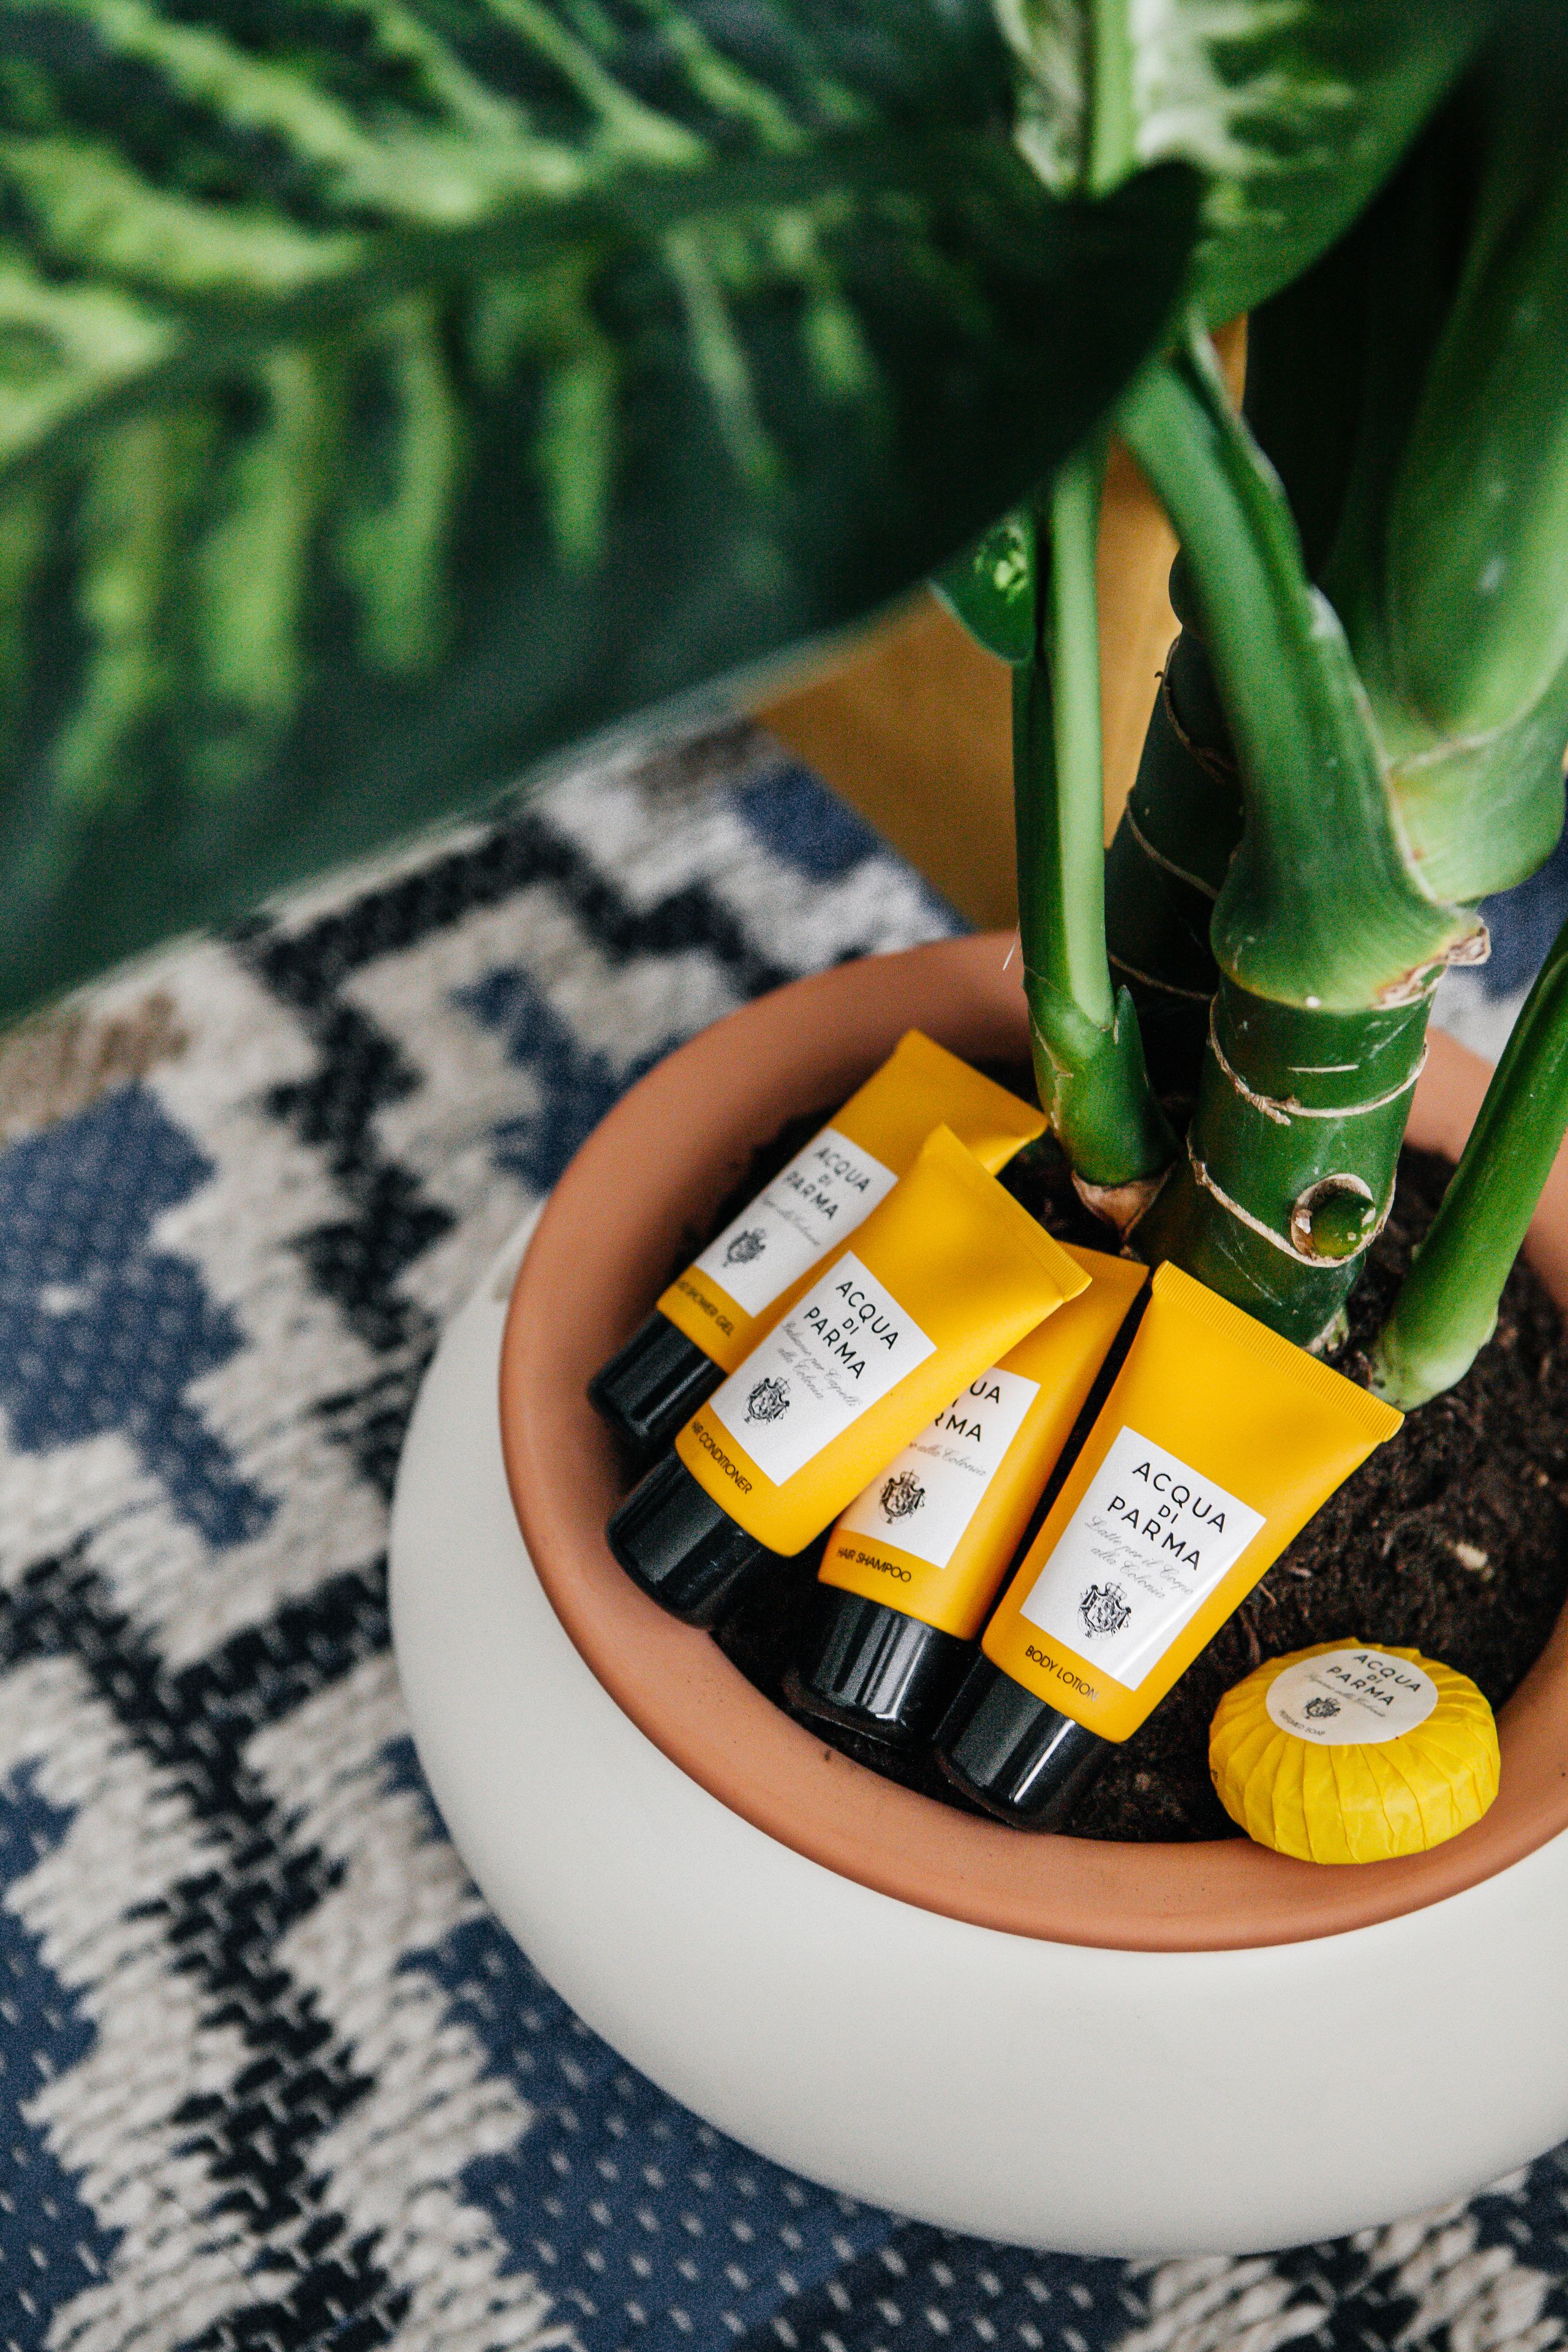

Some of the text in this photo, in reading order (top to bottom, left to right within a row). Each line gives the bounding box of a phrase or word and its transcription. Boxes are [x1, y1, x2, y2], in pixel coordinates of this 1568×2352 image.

[813, 1146, 870, 1193] ACQUA
[783, 1170, 839, 1219] PARMA
[835, 1281, 898, 1349] ACQUA
[842, 1317, 859, 1335] DI
[804, 1306, 865, 1379] PARMA
[699, 1431, 752, 1494] CONDITIONER
[1131, 1461, 1226, 1534] ACQUA
[1158, 1504, 1178, 1524] DI
[1107, 1495, 1200, 1571] PARMA
[1114, 1545, 1143, 1559] per
[856, 1551, 911, 1583] SHAMPOO
[1091, 1547, 1166, 1598] alla Colonia
[1025, 1645, 1099, 1702] BODY LOTION
[1327, 1666, 1394, 1705] PARMA
[1353, 1654, 1422, 1692] ACQUA
[1366, 1674, 1382, 1684] DI
